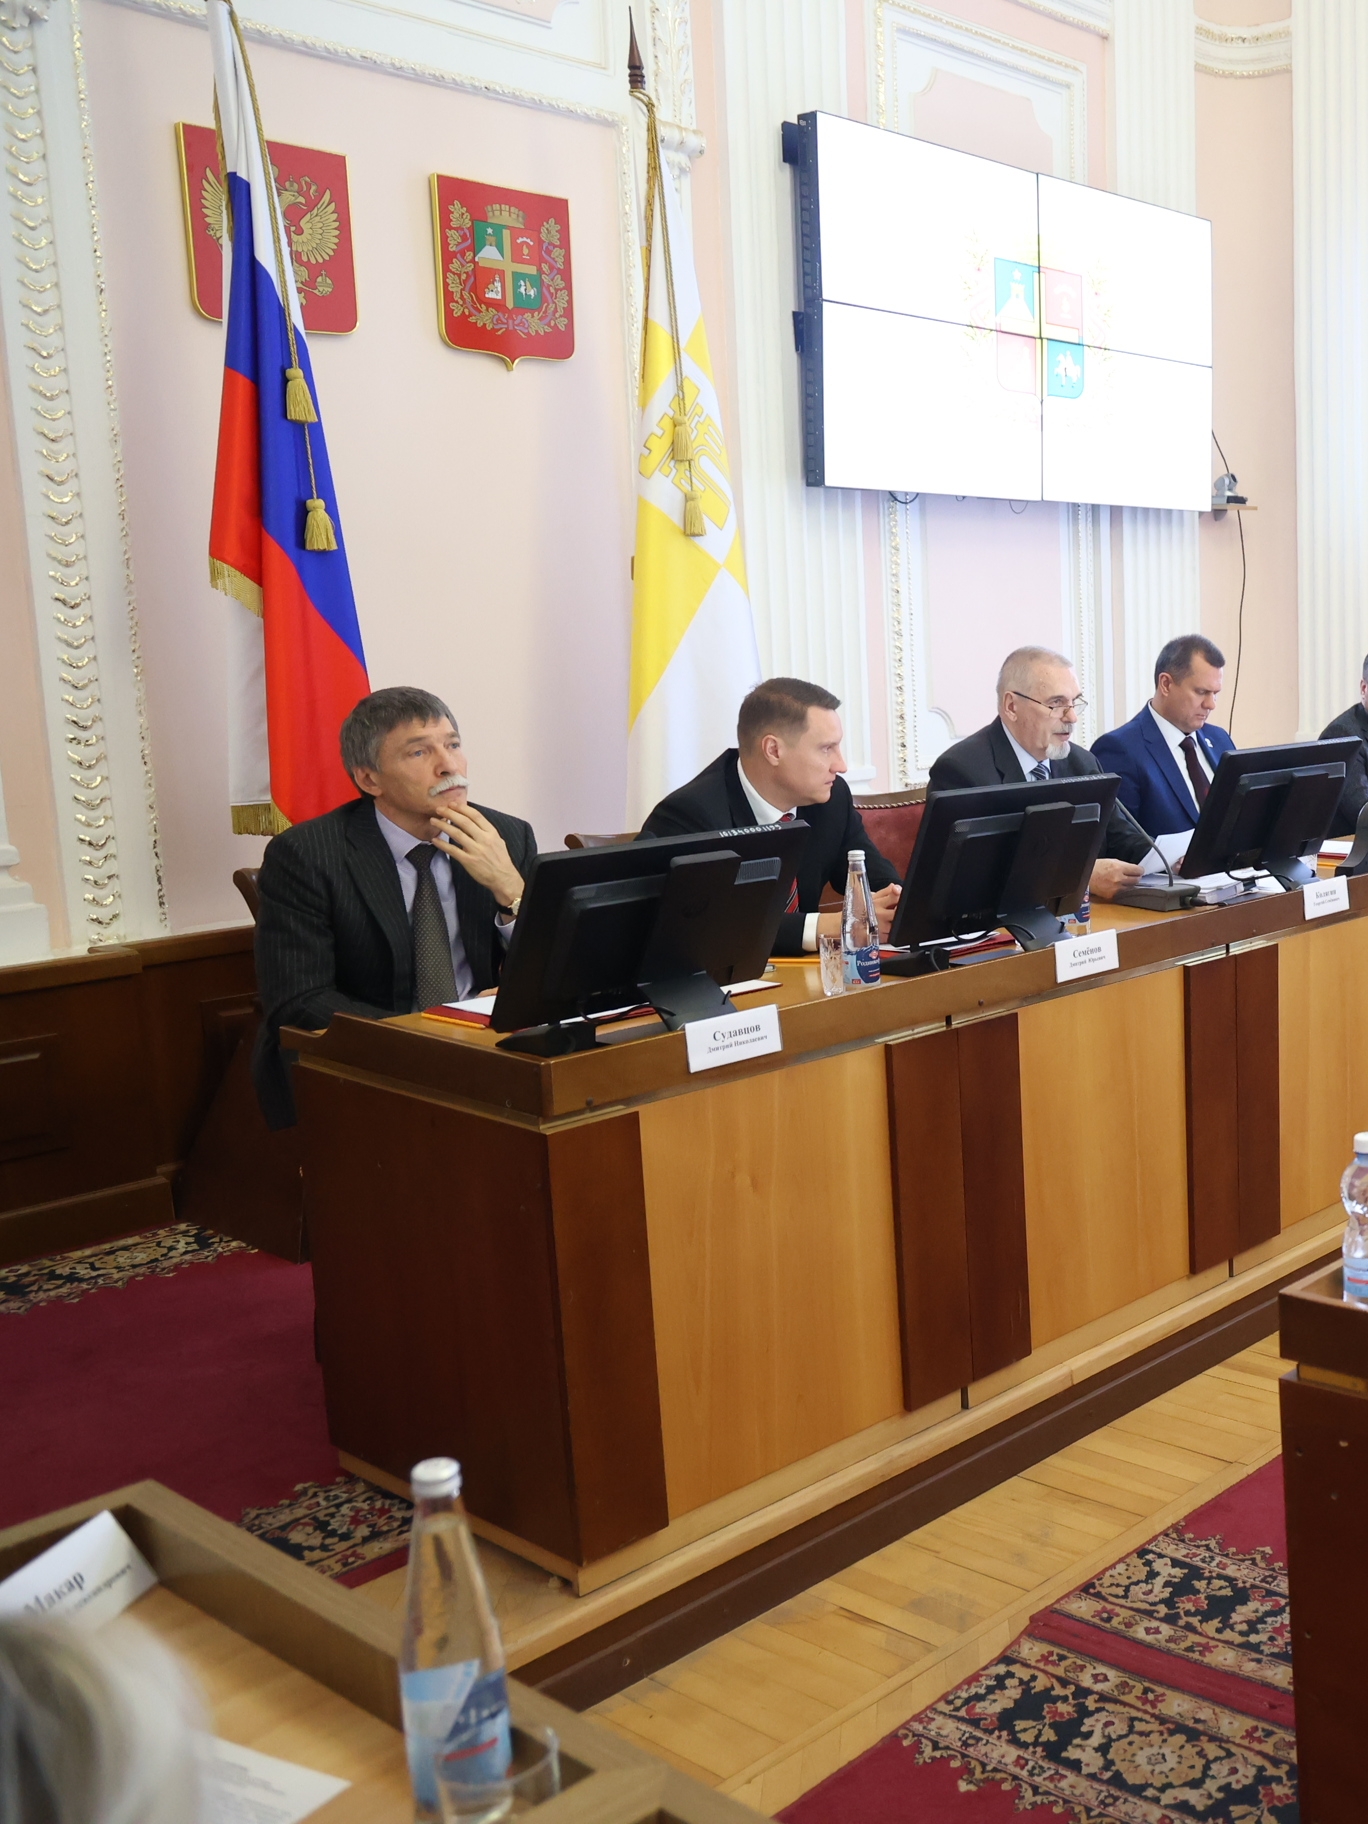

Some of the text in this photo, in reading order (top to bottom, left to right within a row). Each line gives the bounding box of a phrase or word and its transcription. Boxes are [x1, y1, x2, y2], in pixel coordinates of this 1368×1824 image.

[1072, 946, 1102, 959] Семёнов
[713, 1024, 761, 1043] Судавцов
[707, 1034, 768, 1054] Дмитрий Николаевич
